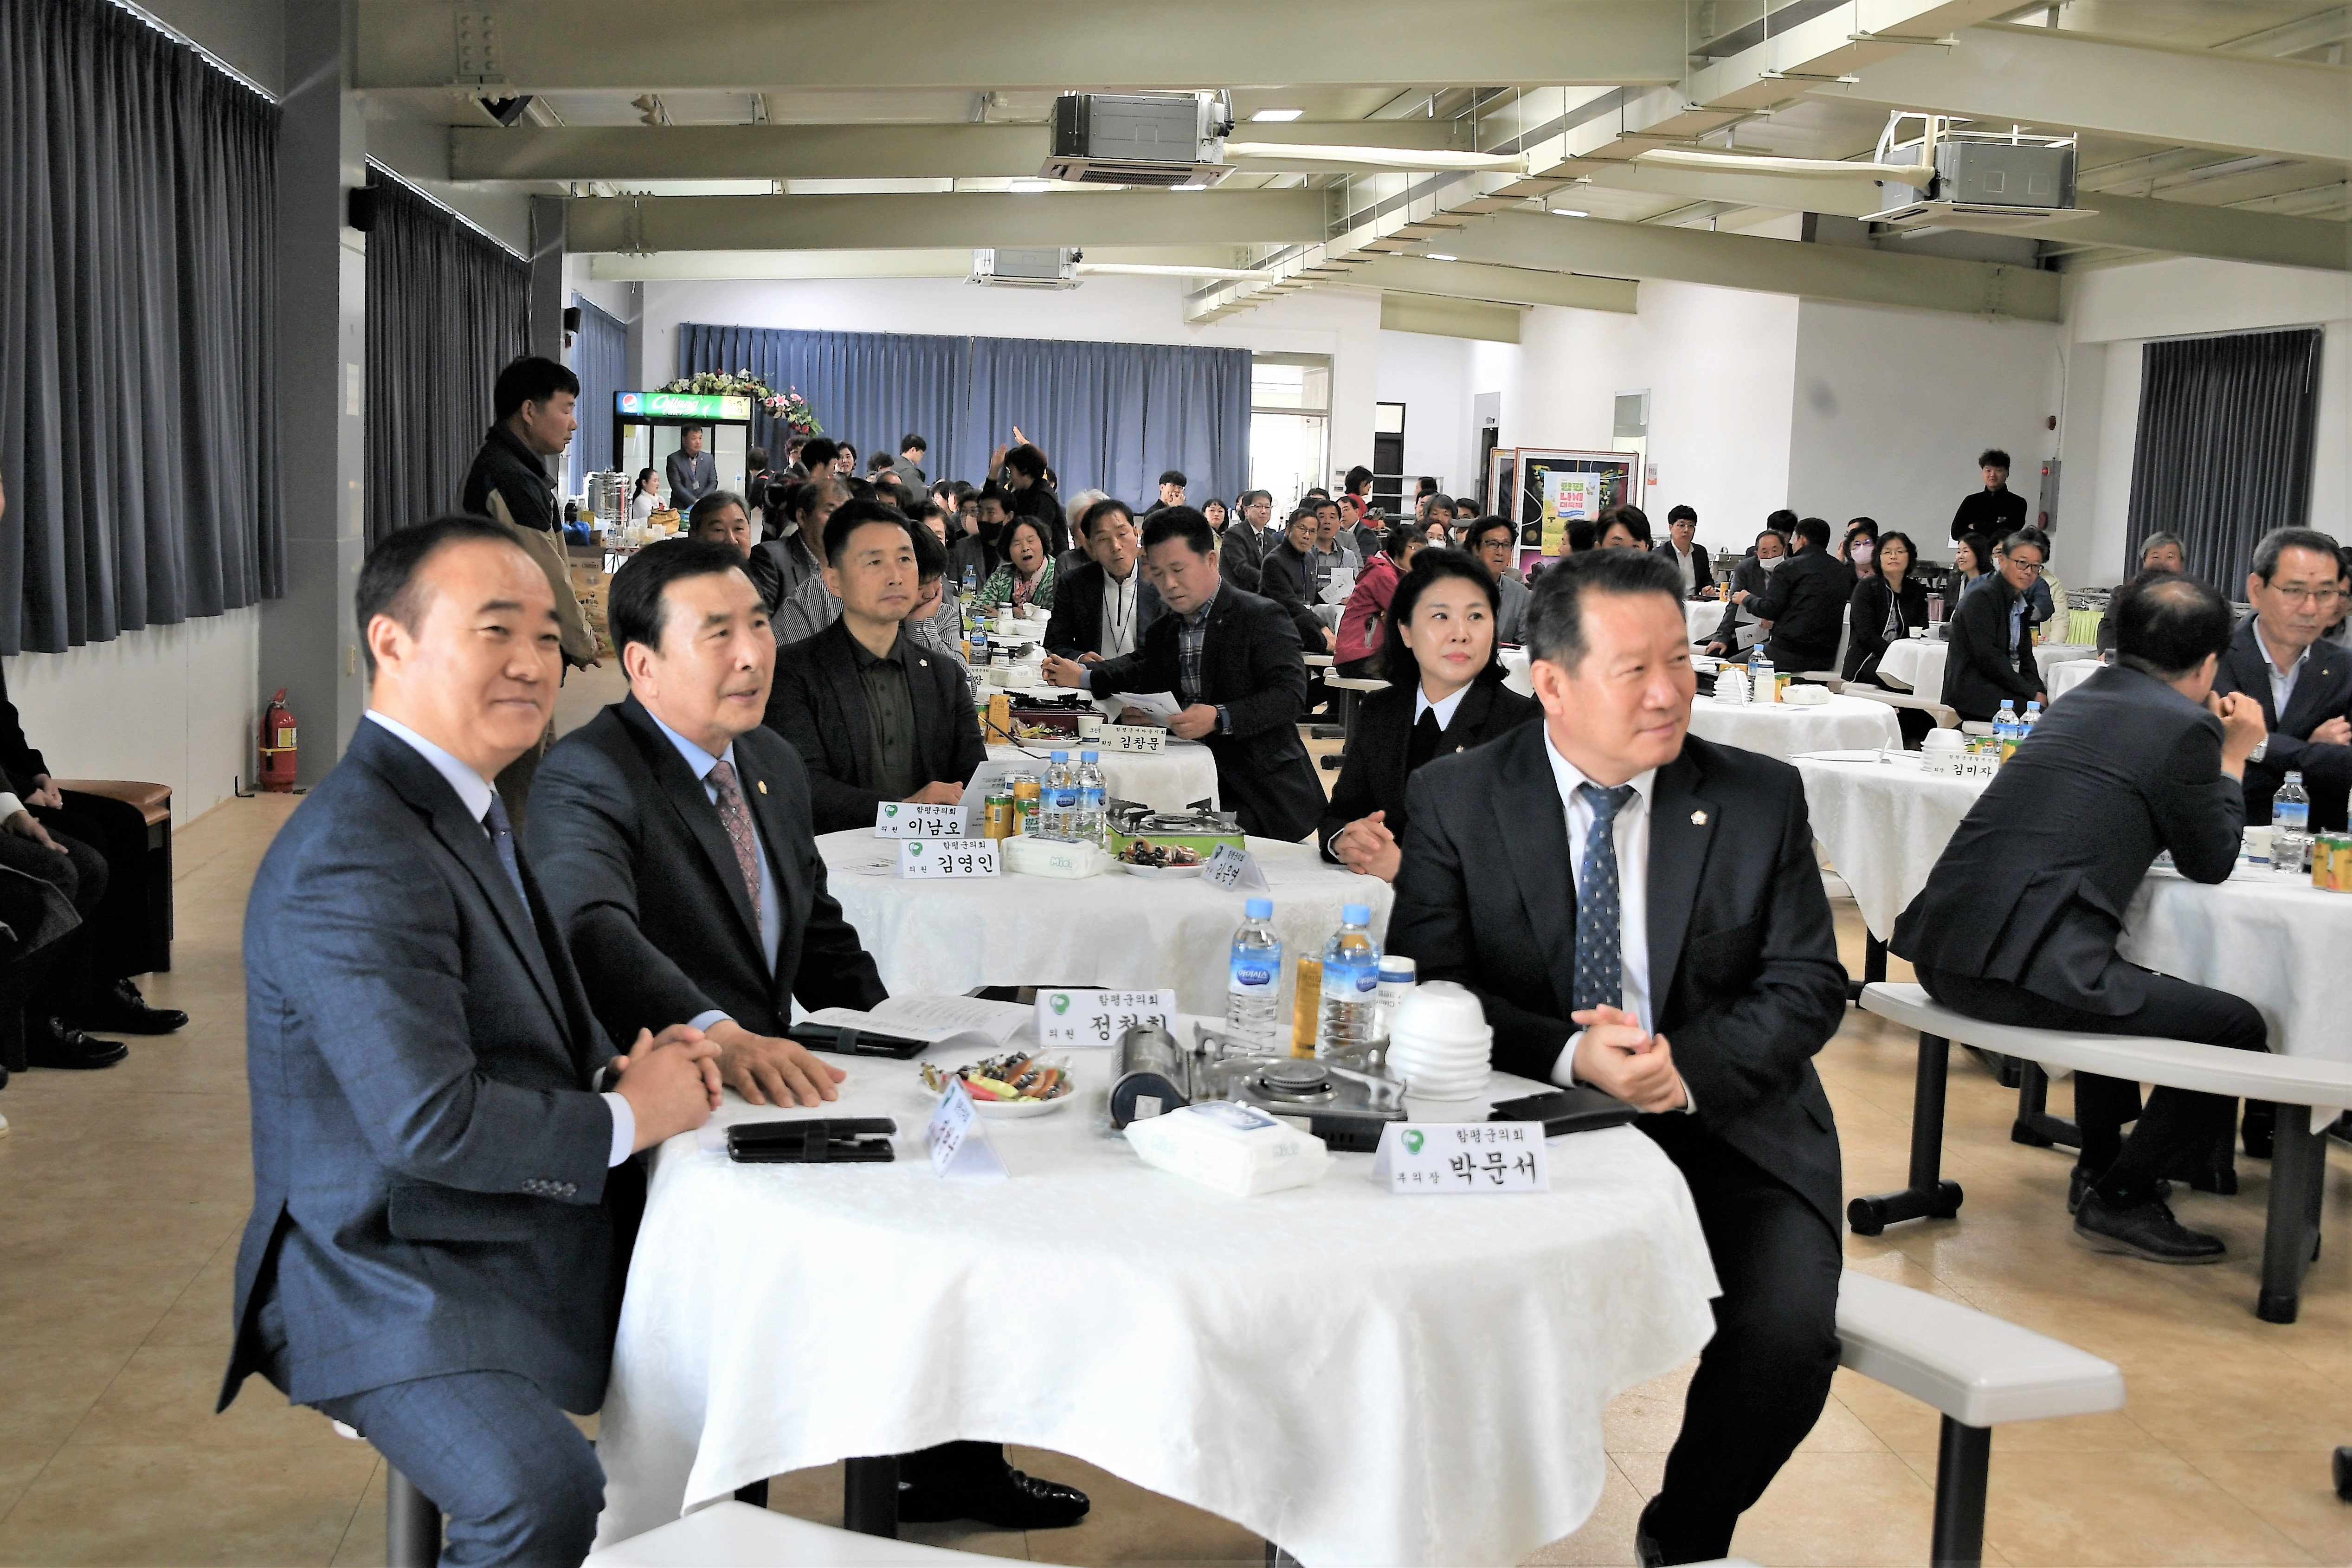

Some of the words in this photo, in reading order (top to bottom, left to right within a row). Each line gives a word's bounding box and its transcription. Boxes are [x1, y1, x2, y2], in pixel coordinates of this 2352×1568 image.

[1560, 492, 1583, 501] 나비
[1120, 736, 1159, 751] 김창문
[1953, 763, 1992, 778] 김미자
[917, 806, 956, 815] 함평군의회
[909, 818, 960, 836] 이남오
[943, 841, 986, 850] 함평군의회
[937, 854, 993, 873] 김영인
[1099, 994, 1158, 1006] 함평군의회
[1456, 1128, 1523, 1142] 함평군의회
[1448, 1151, 1535, 1185] 박문서
